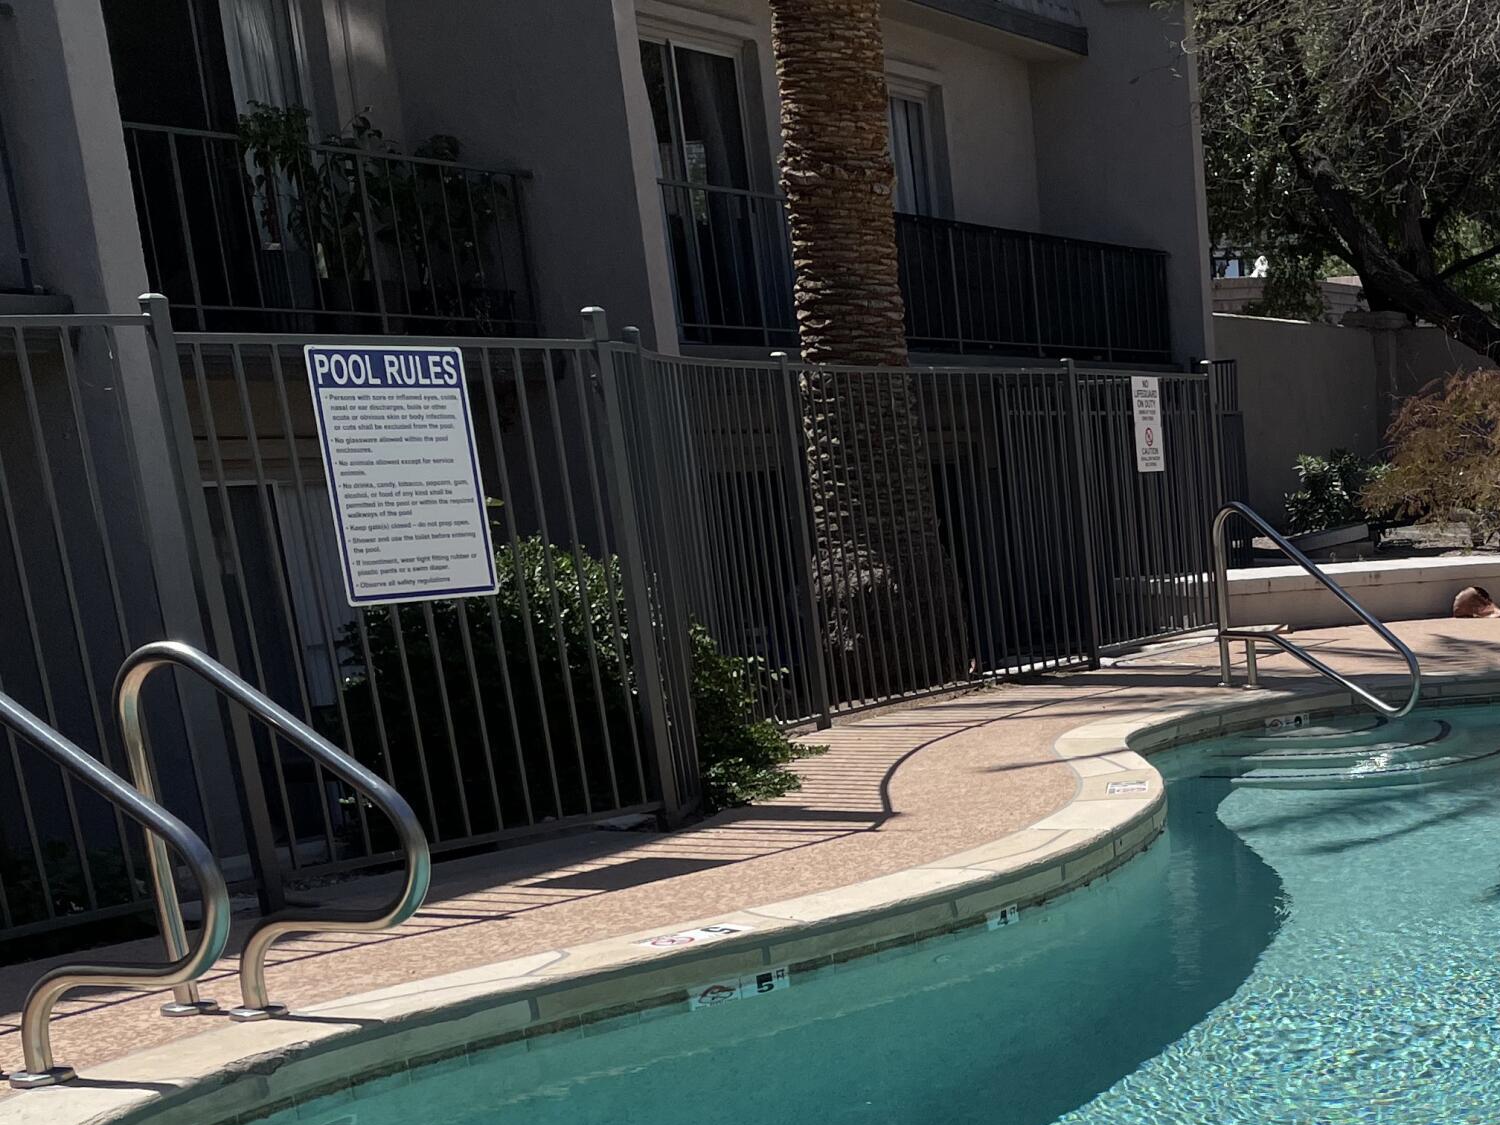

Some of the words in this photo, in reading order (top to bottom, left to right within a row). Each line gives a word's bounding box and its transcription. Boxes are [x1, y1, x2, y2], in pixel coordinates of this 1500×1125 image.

[314, 354, 382, 385] POOL
[384, 354, 458, 385] RULES
[1142, 380, 1149, 388] NO
[1137, 400, 1144, 408] ON
[1145, 400, 1156, 408] DUTY
[756, 972, 774, 993] 5
